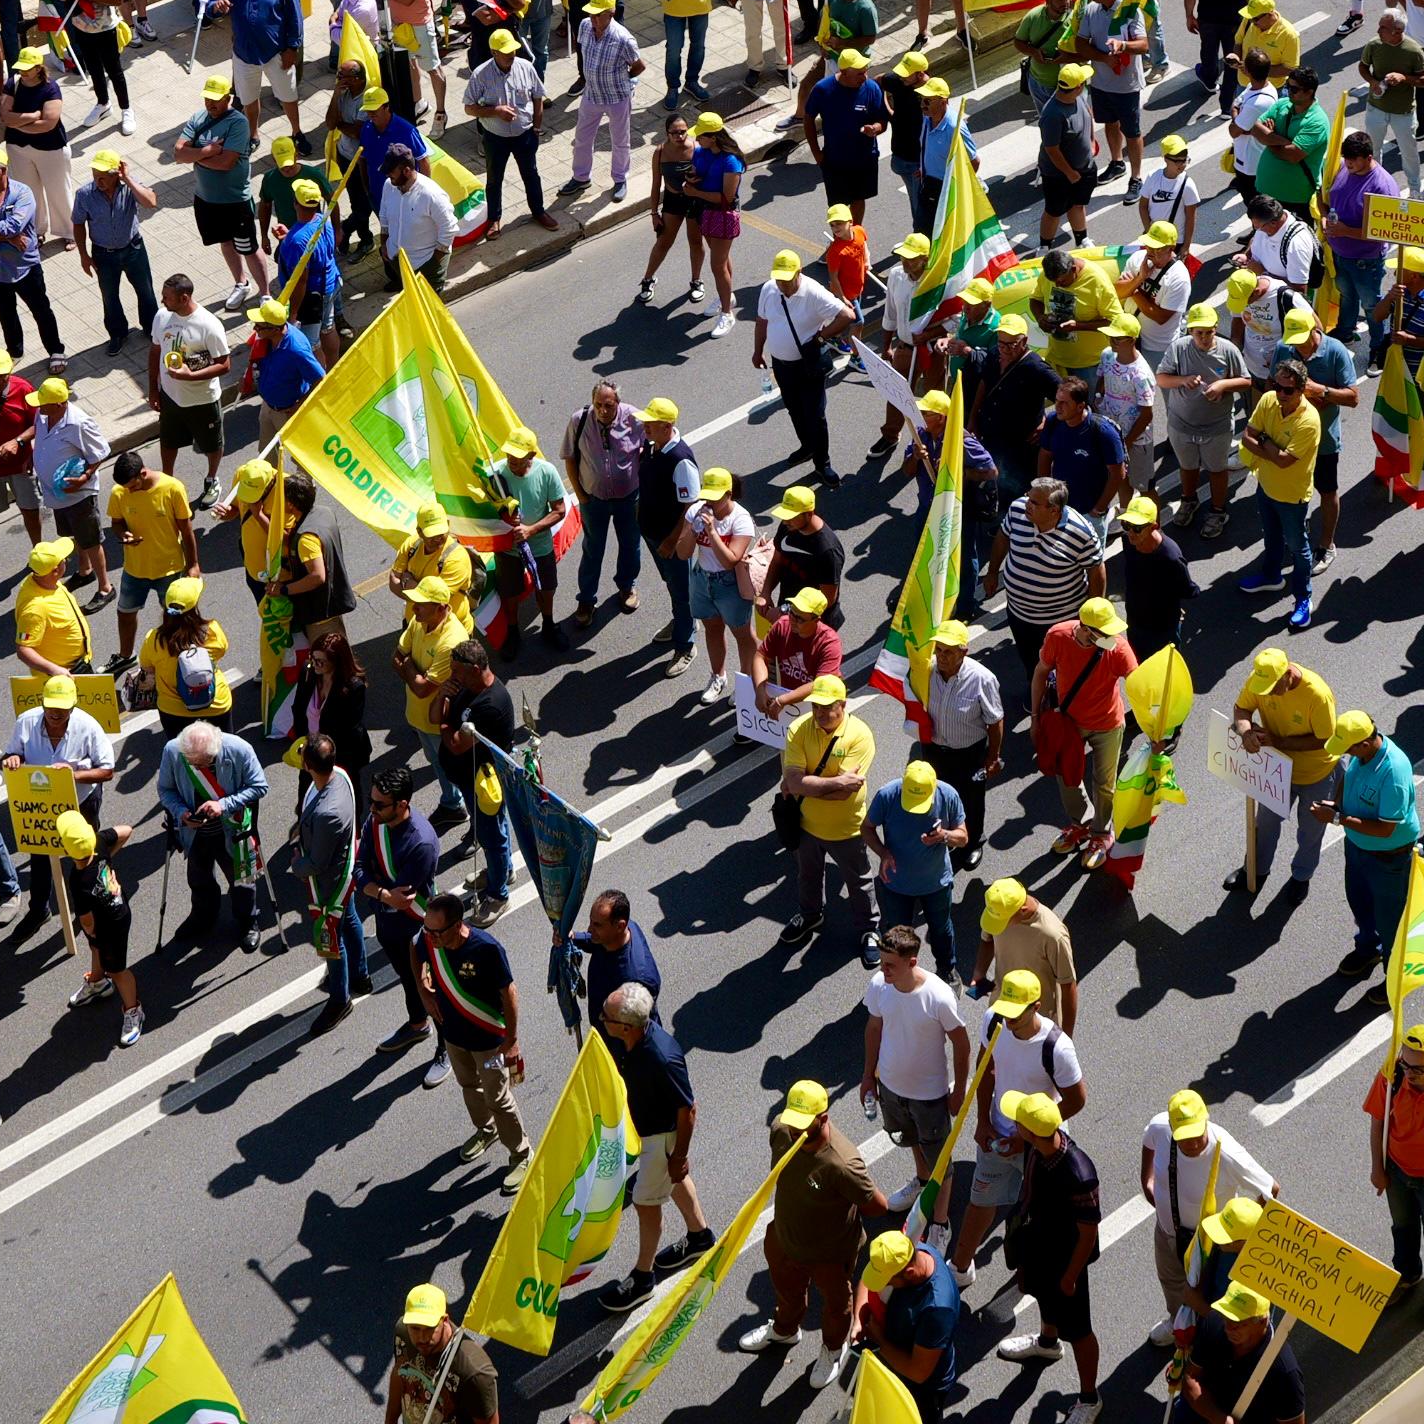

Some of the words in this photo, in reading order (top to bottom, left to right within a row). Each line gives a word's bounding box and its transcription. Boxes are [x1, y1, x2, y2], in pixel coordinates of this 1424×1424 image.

[1392, 222, 1412, 233] PER
[322, 434, 417, 530] COLDIRET
[740, 708, 790, 738] SICCI
[1213, 752, 1285, 804] CINGHIALI
[13, 800, 48, 814] SIAMO
[51, 802, 75, 815] CON
[22, 818, 57, 831] L'ACQ
[20, 835, 48, 847] ALLA
[1337, 1247, 1351, 1261] E
[1247, 1247, 1318, 1292] CONTRO
[1256, 1228, 1340, 1282] CAMPAGNA
[1345, 1276, 1392, 1314] UNITE
[1239, 1263, 1337, 1328] CINGHIALI
